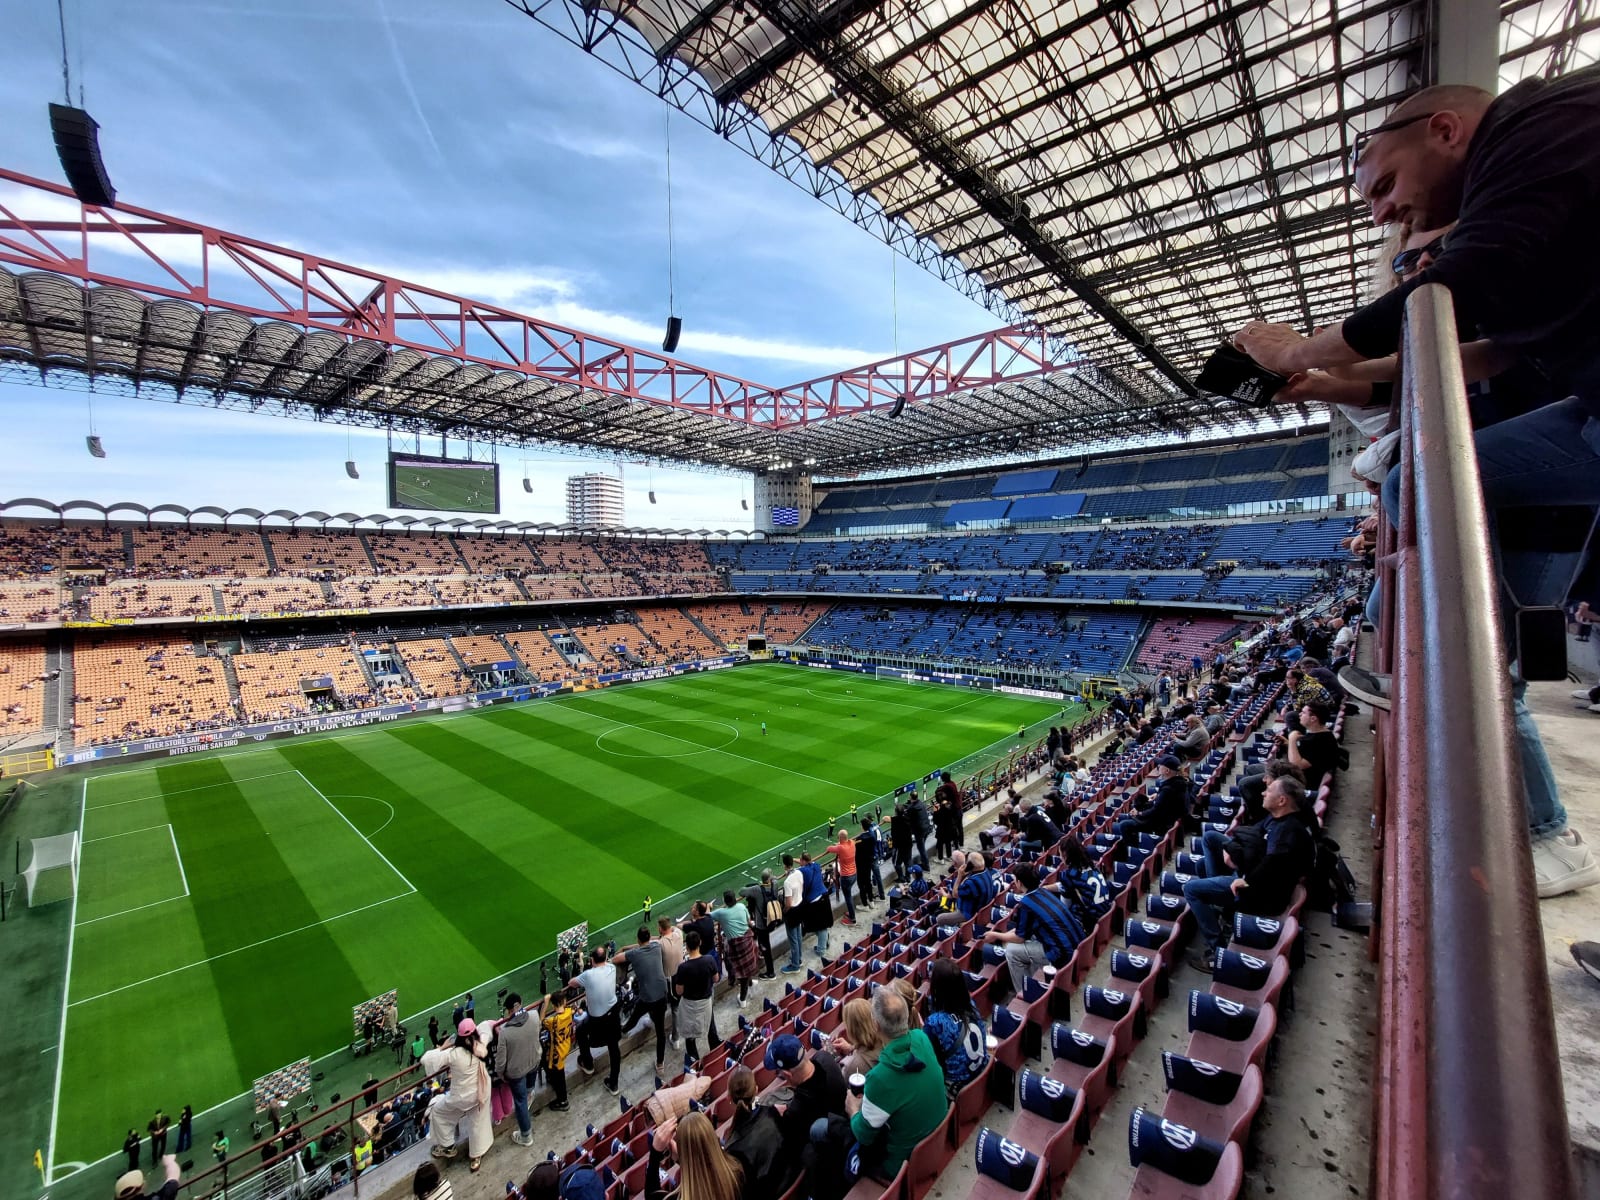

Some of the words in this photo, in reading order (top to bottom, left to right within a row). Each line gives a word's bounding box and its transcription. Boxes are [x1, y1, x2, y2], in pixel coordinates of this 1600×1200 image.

[318, 608, 369, 617] CATTOLICA
[273, 723, 291, 732] GET
[361, 710, 381, 718] NOW
[144, 742, 164, 751] INTER
[165, 739, 186, 747] STORE
[186, 736, 200, 744] SAN
[169, 747, 188, 756] INTER
[189, 744, 209, 753] STORE
[210, 741, 223, 749] SAN
[223, 739, 239, 747] SIRO
[73, 750, 97, 762] INTER
[1132, 1113, 1141, 1148] DESTINO
